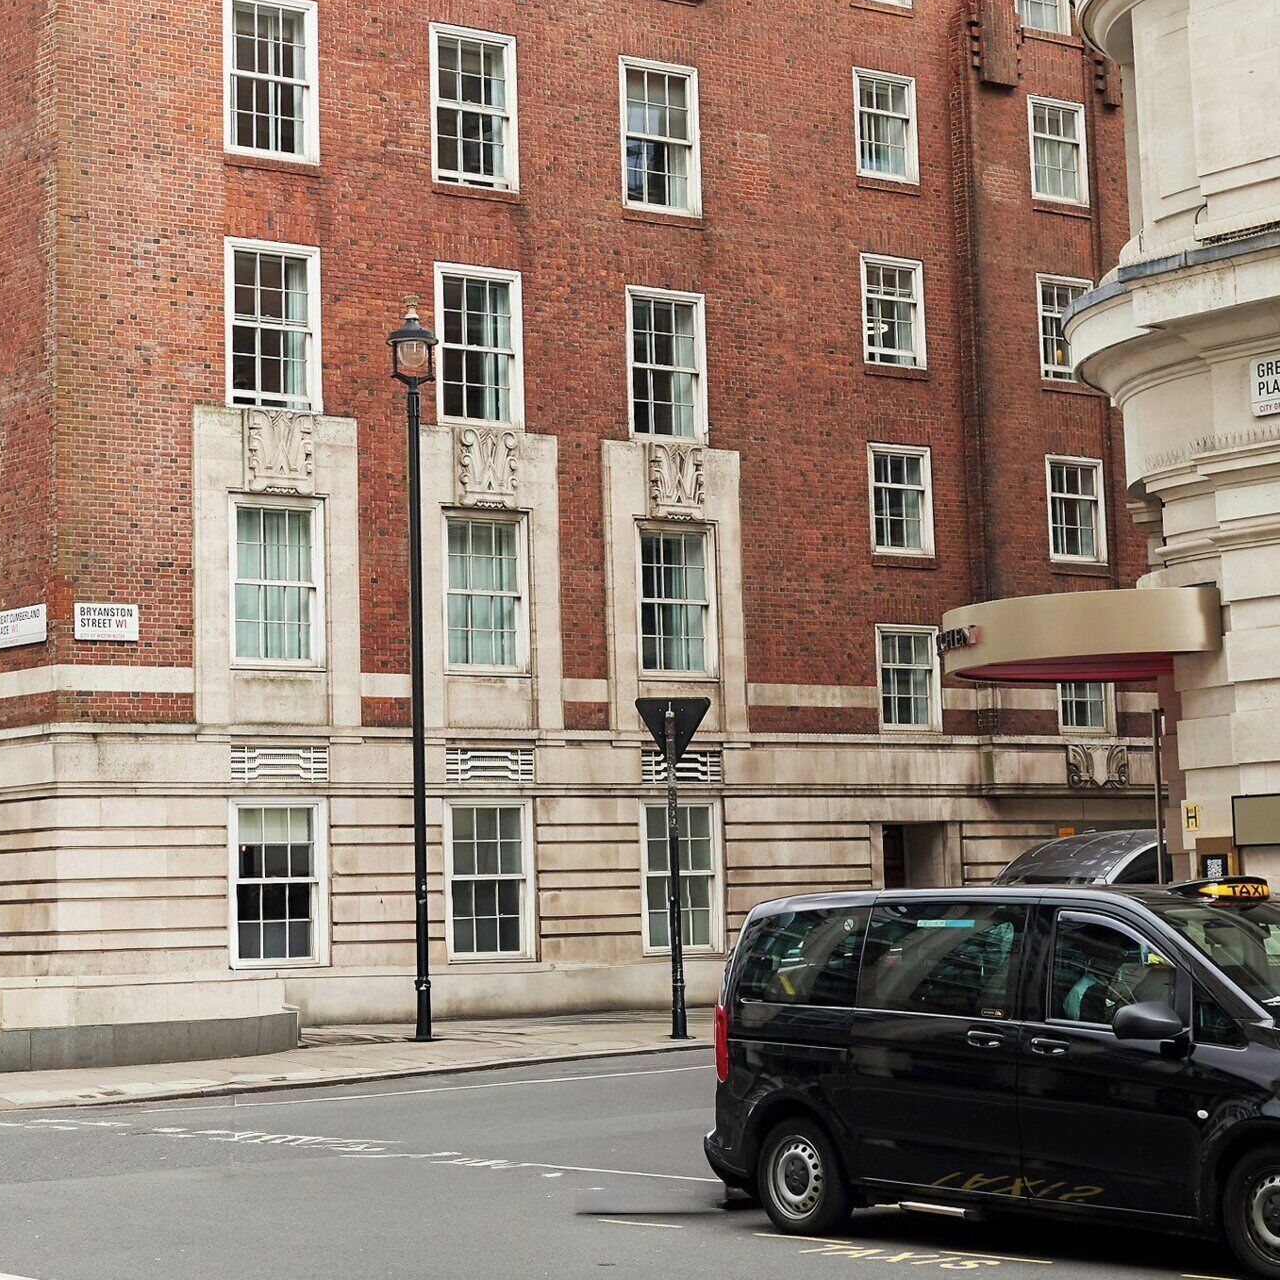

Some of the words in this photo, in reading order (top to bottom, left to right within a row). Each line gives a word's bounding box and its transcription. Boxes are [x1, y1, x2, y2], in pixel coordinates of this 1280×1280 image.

[1259, 403, 1271, 413] CITY
[10, 608, 40, 623] CUMBERLAND
[80, 606, 133, 617] BRYANSTON
[80, 618, 111, 628] STREET
[115, 619, 127, 628] W1
[1186, 806, 1198, 828] H
[1227, 885, 1265, 897] TAXI
[798, 1244, 1000, 1270] TAXIS
